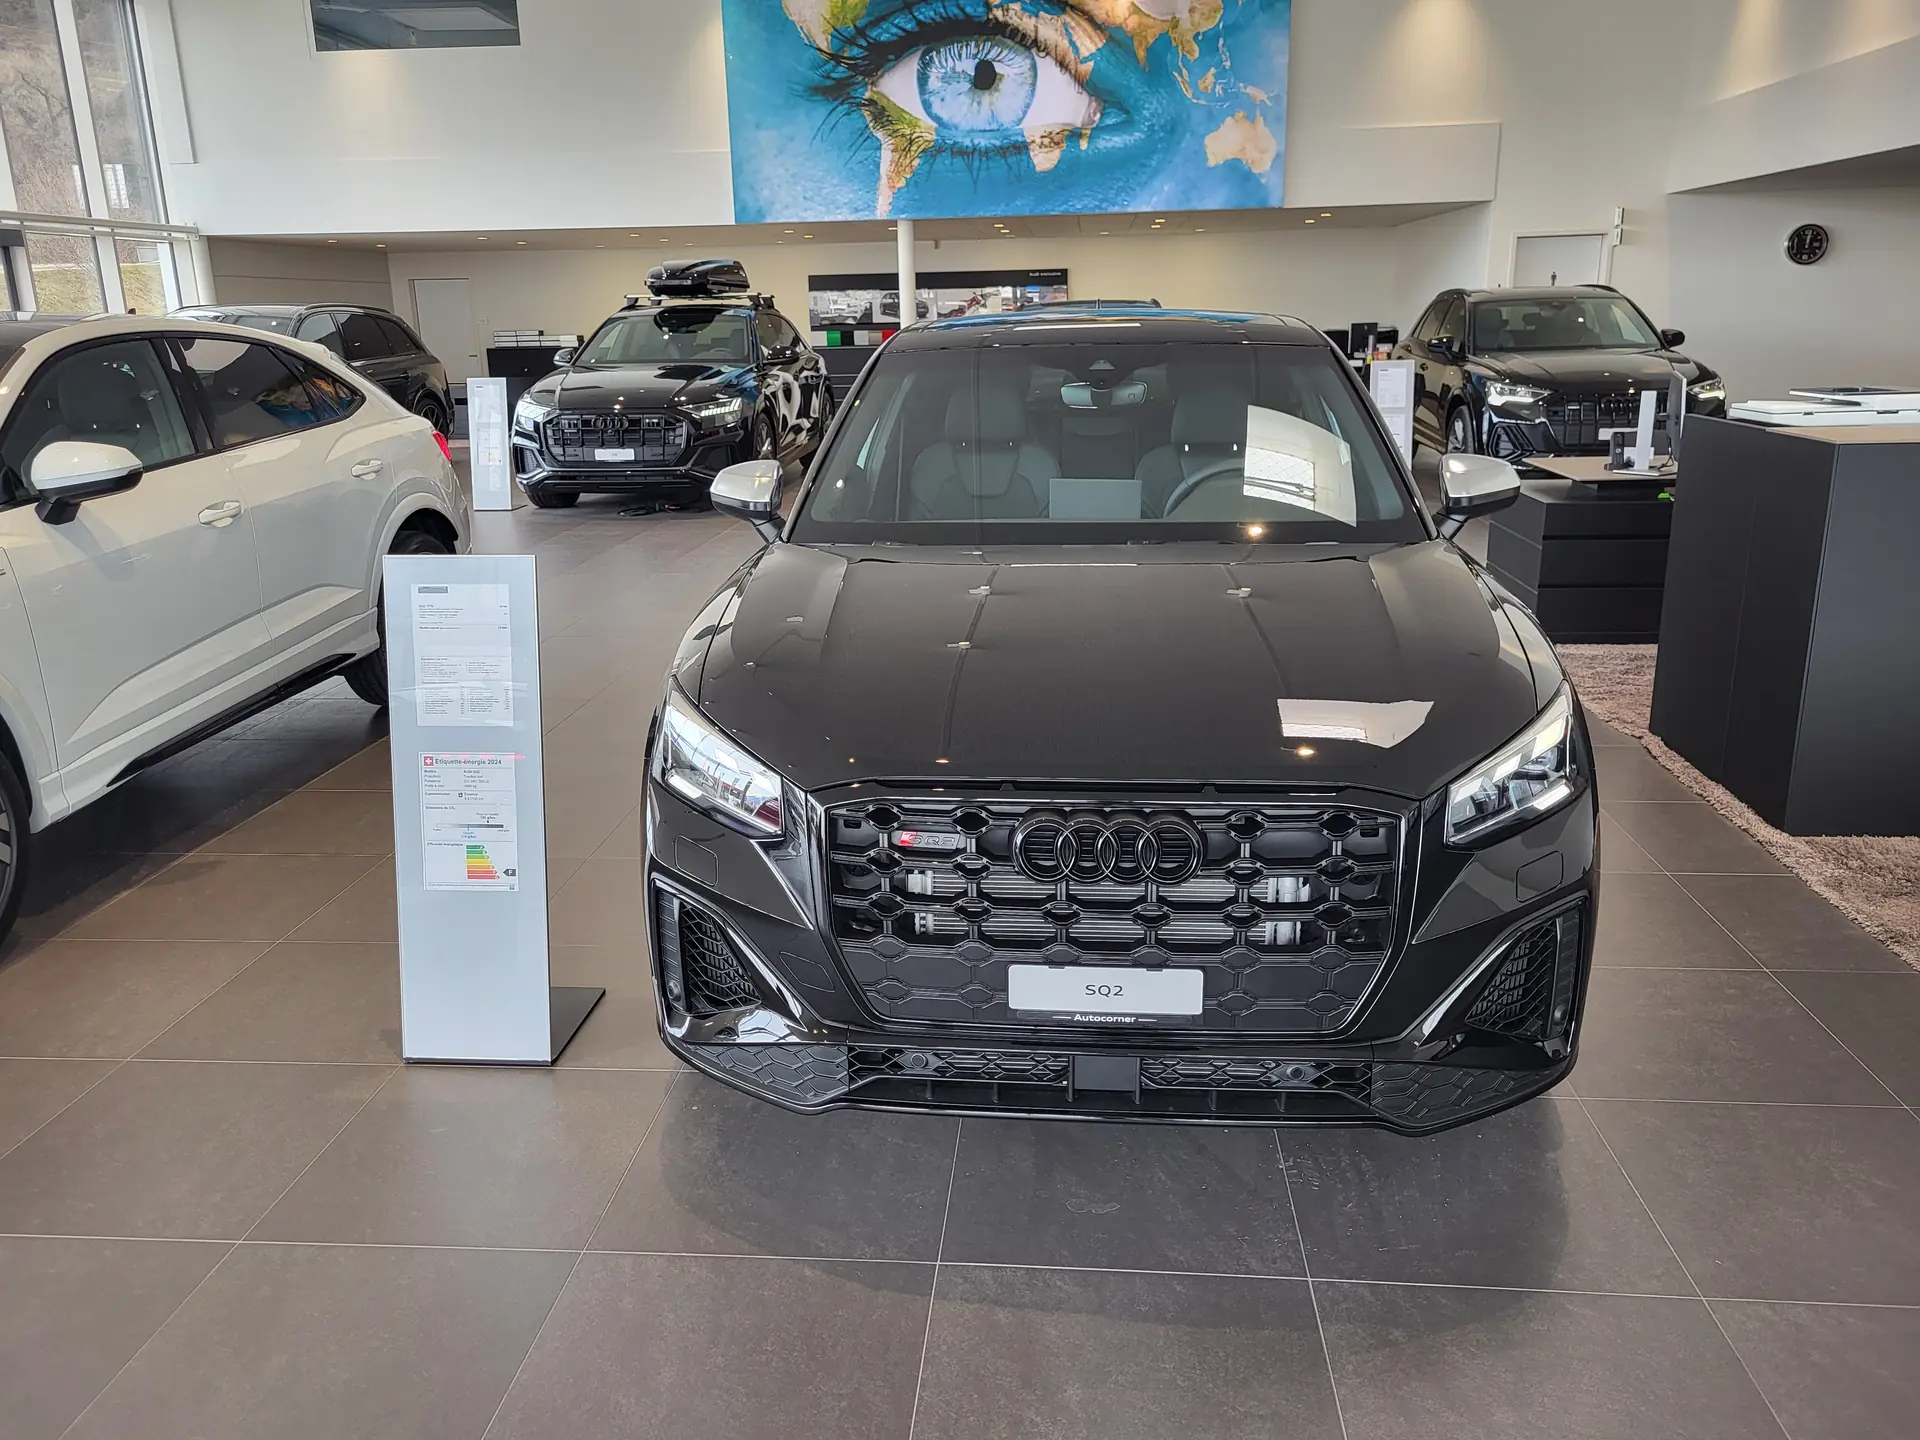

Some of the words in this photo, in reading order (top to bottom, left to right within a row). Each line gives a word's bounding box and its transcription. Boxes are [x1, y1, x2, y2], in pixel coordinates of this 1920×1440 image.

[487, 758, 502, 766] 2024
[908, 833, 955, 847] SQ2
[1084, 984, 1124, 998] SQ2
[1073, 1013, 1137, 1024] Autocorner
